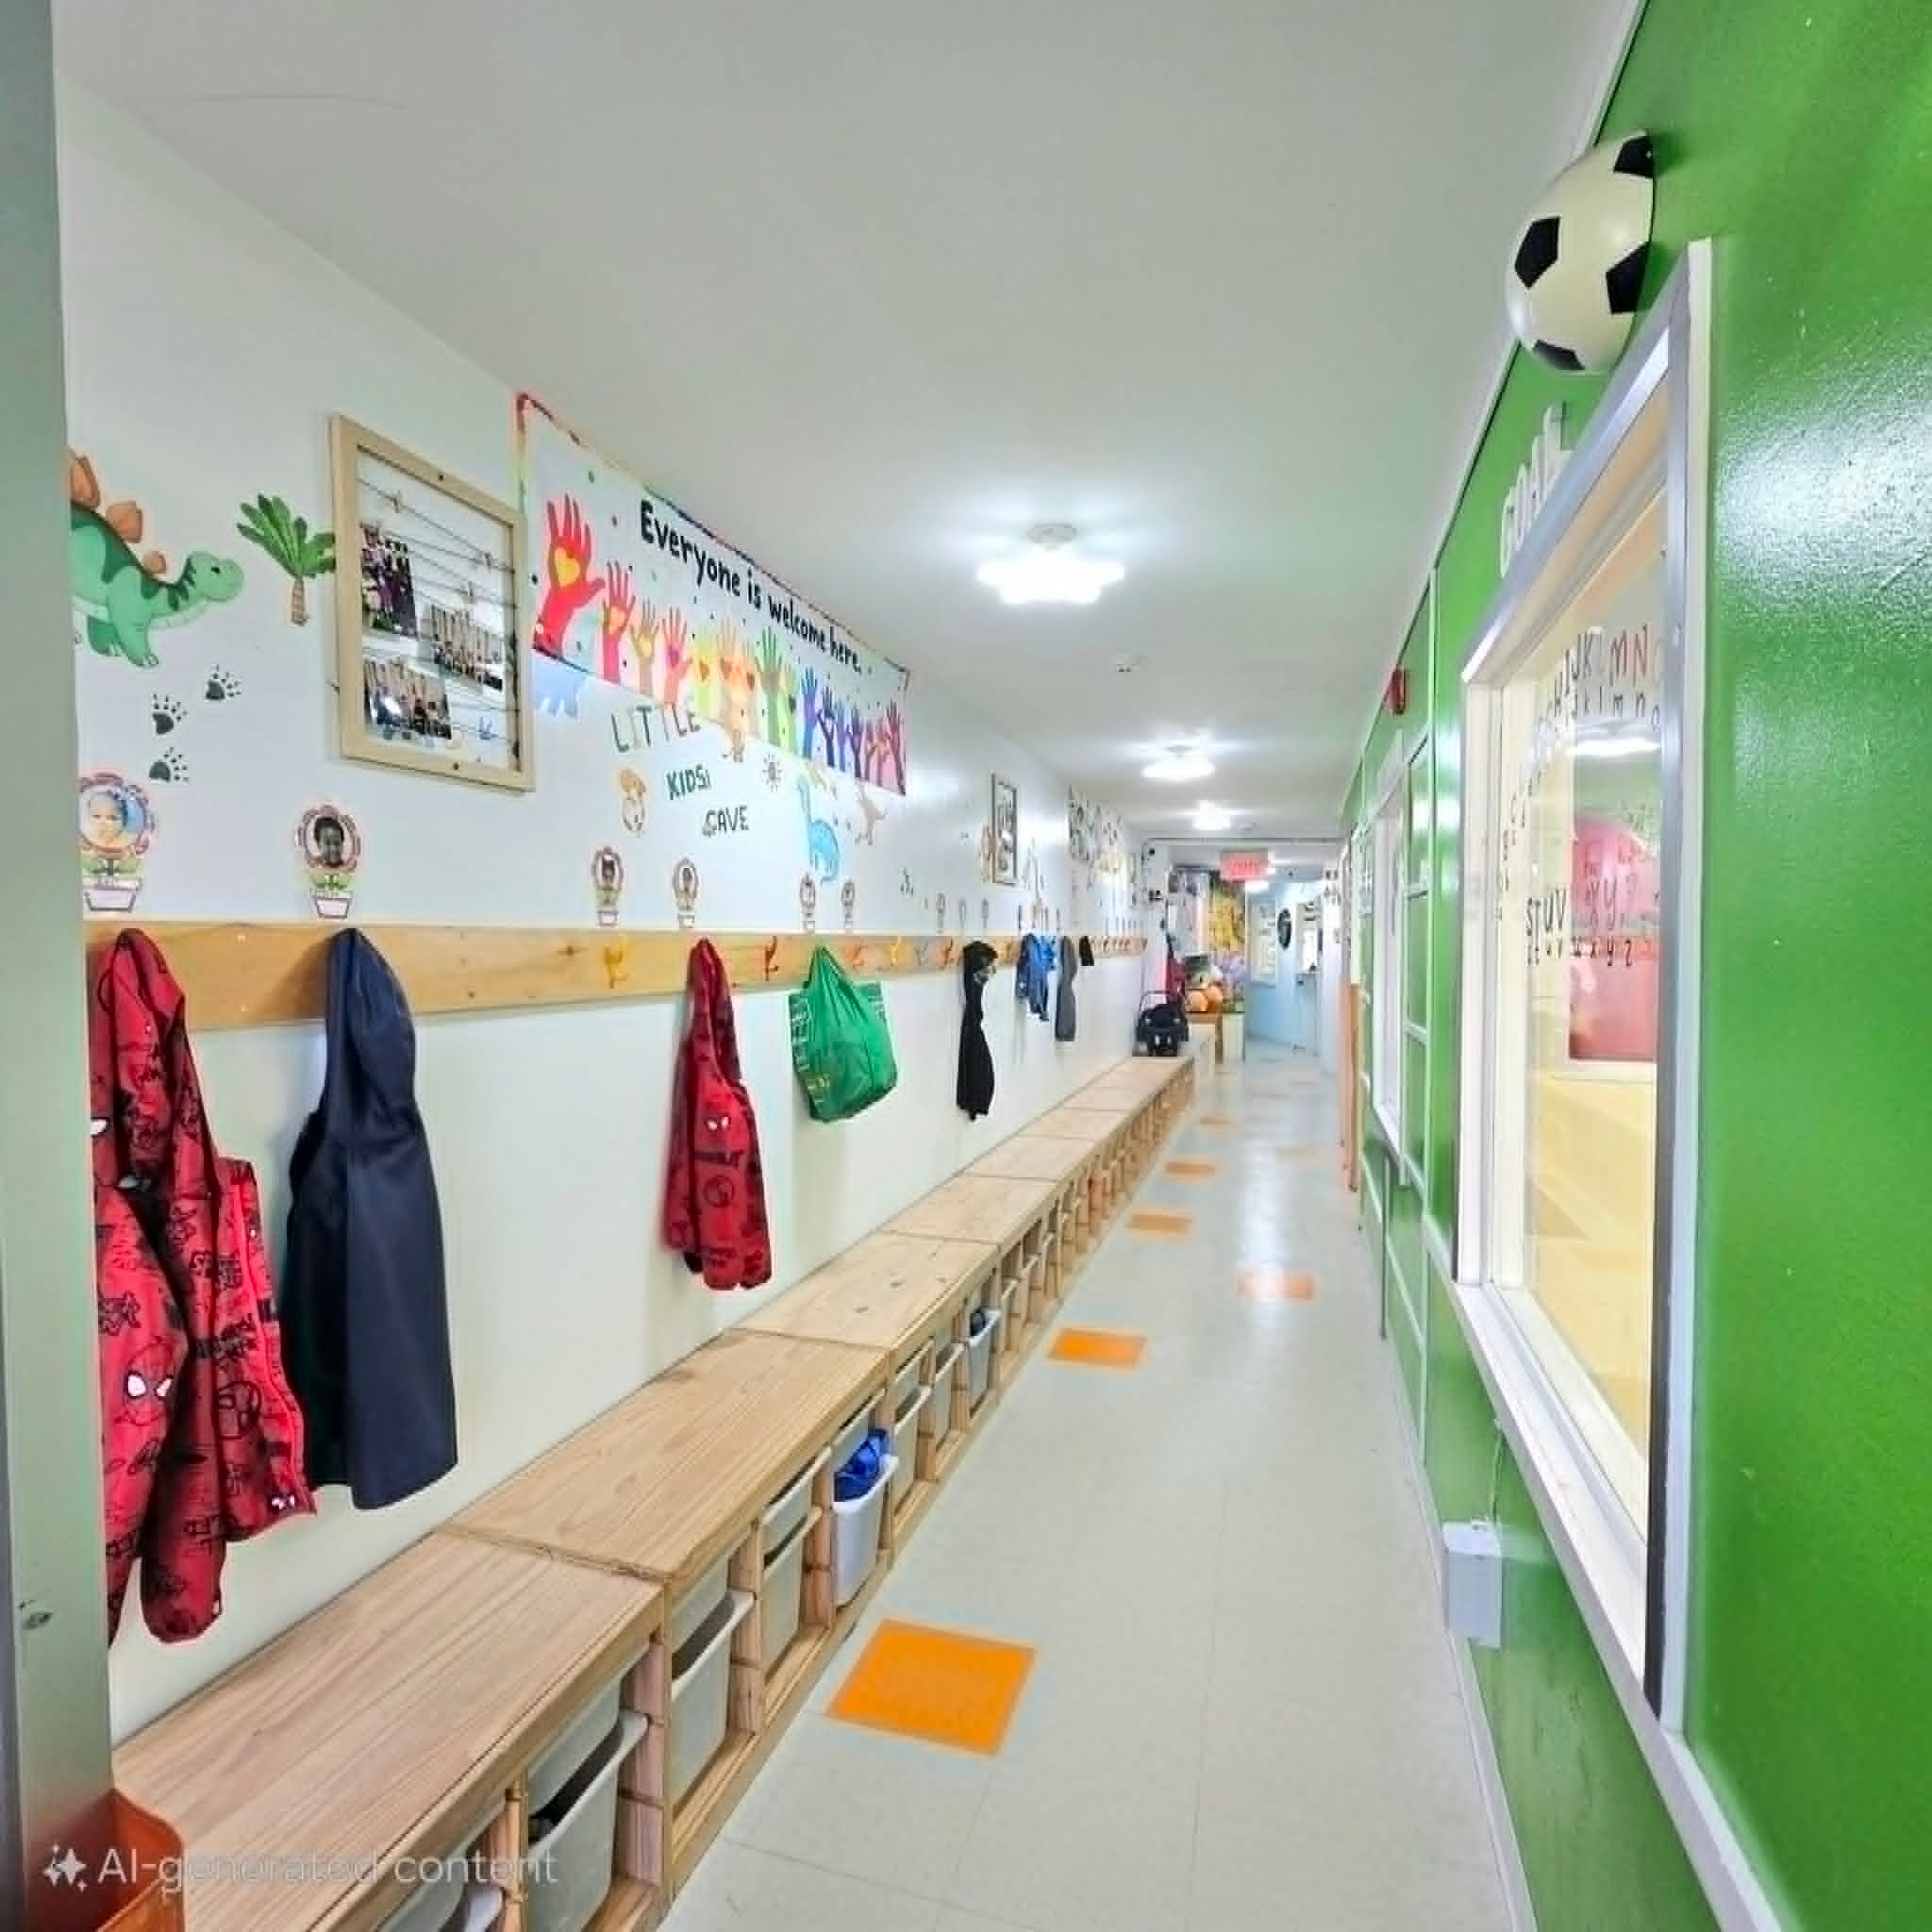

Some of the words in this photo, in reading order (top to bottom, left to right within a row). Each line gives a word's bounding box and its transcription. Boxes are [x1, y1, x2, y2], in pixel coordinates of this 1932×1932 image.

[641, 499, 741, 596] Everyone
[747, 566, 761, 609] is
[768, 593, 826, 653] welcome
